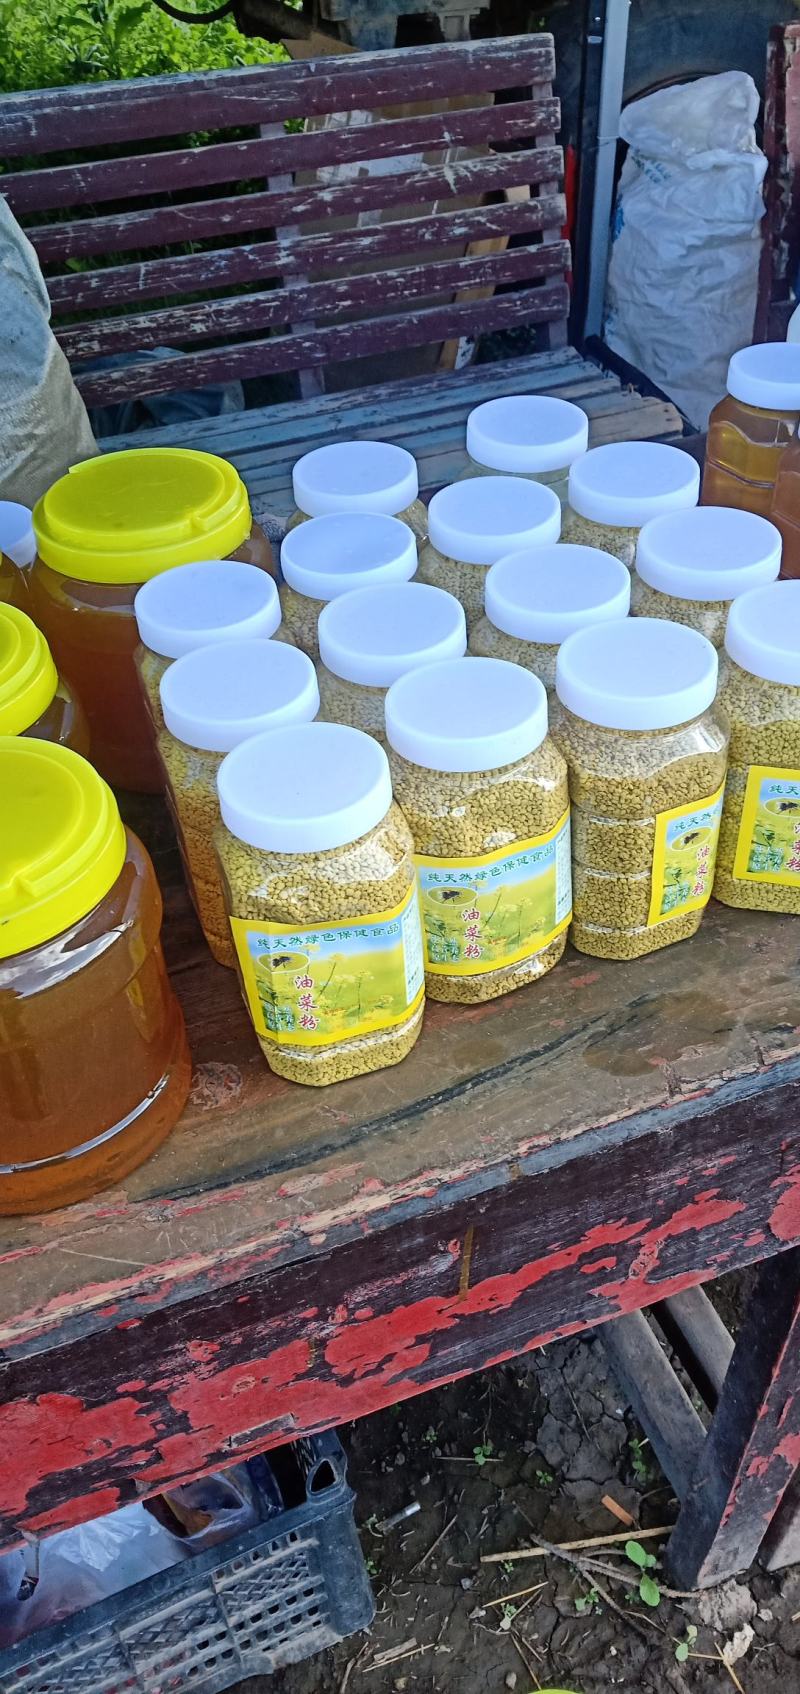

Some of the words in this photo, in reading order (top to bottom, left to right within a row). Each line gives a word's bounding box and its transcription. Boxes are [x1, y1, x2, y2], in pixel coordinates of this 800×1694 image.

[427, 842, 554, 884] 纯天然绿色保健食品
[257, 923, 399, 950] 纯天然绿色保健食品
[461, 907, 484, 959] 油菜粉
[294, 974, 320, 1031] 油菜粉
